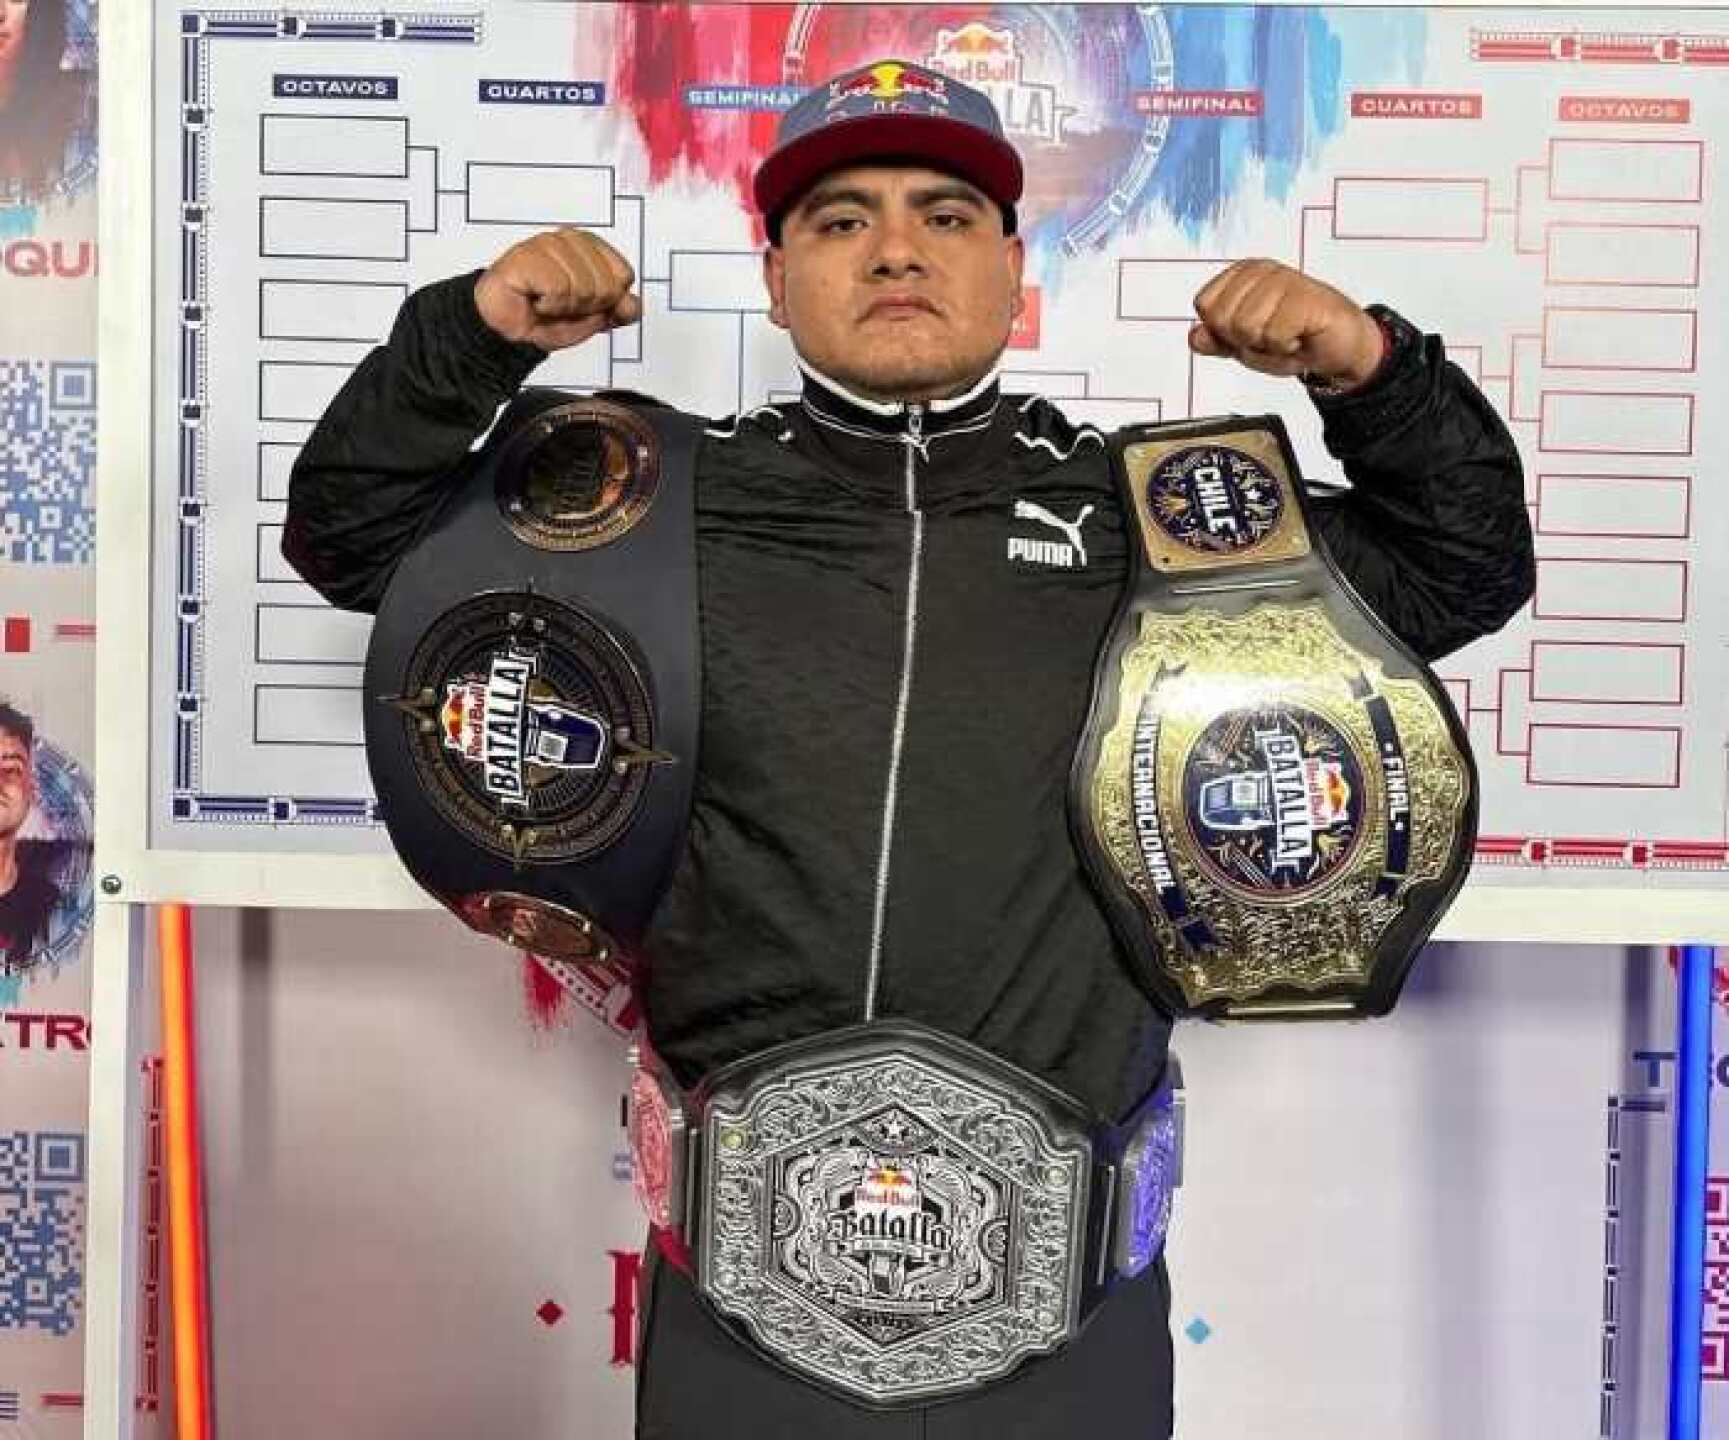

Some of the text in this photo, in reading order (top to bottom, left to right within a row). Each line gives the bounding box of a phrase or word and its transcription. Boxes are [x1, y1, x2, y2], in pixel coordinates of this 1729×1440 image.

[975, 60, 1016, 80] Bull
[282, 80, 389, 95] OCTAVOS
[487, 84, 597, 101] CUARTOS
[1136, 95, 1258, 111] SEMIFINAL
[1360, 98, 1473, 115] CUARTOS
[1567, 102, 1681, 118] OCTAVOS
[1194, 466, 1237, 533] CHILE
[1007, 537, 1073, 567] PUMA
[487, 668, 528, 793] BATALLA
[1269, 738, 1310, 857] BATALLA
[1383, 757, 1409, 821] FINAL
[1133, 715, 1175, 895] INTERNACIONAL
